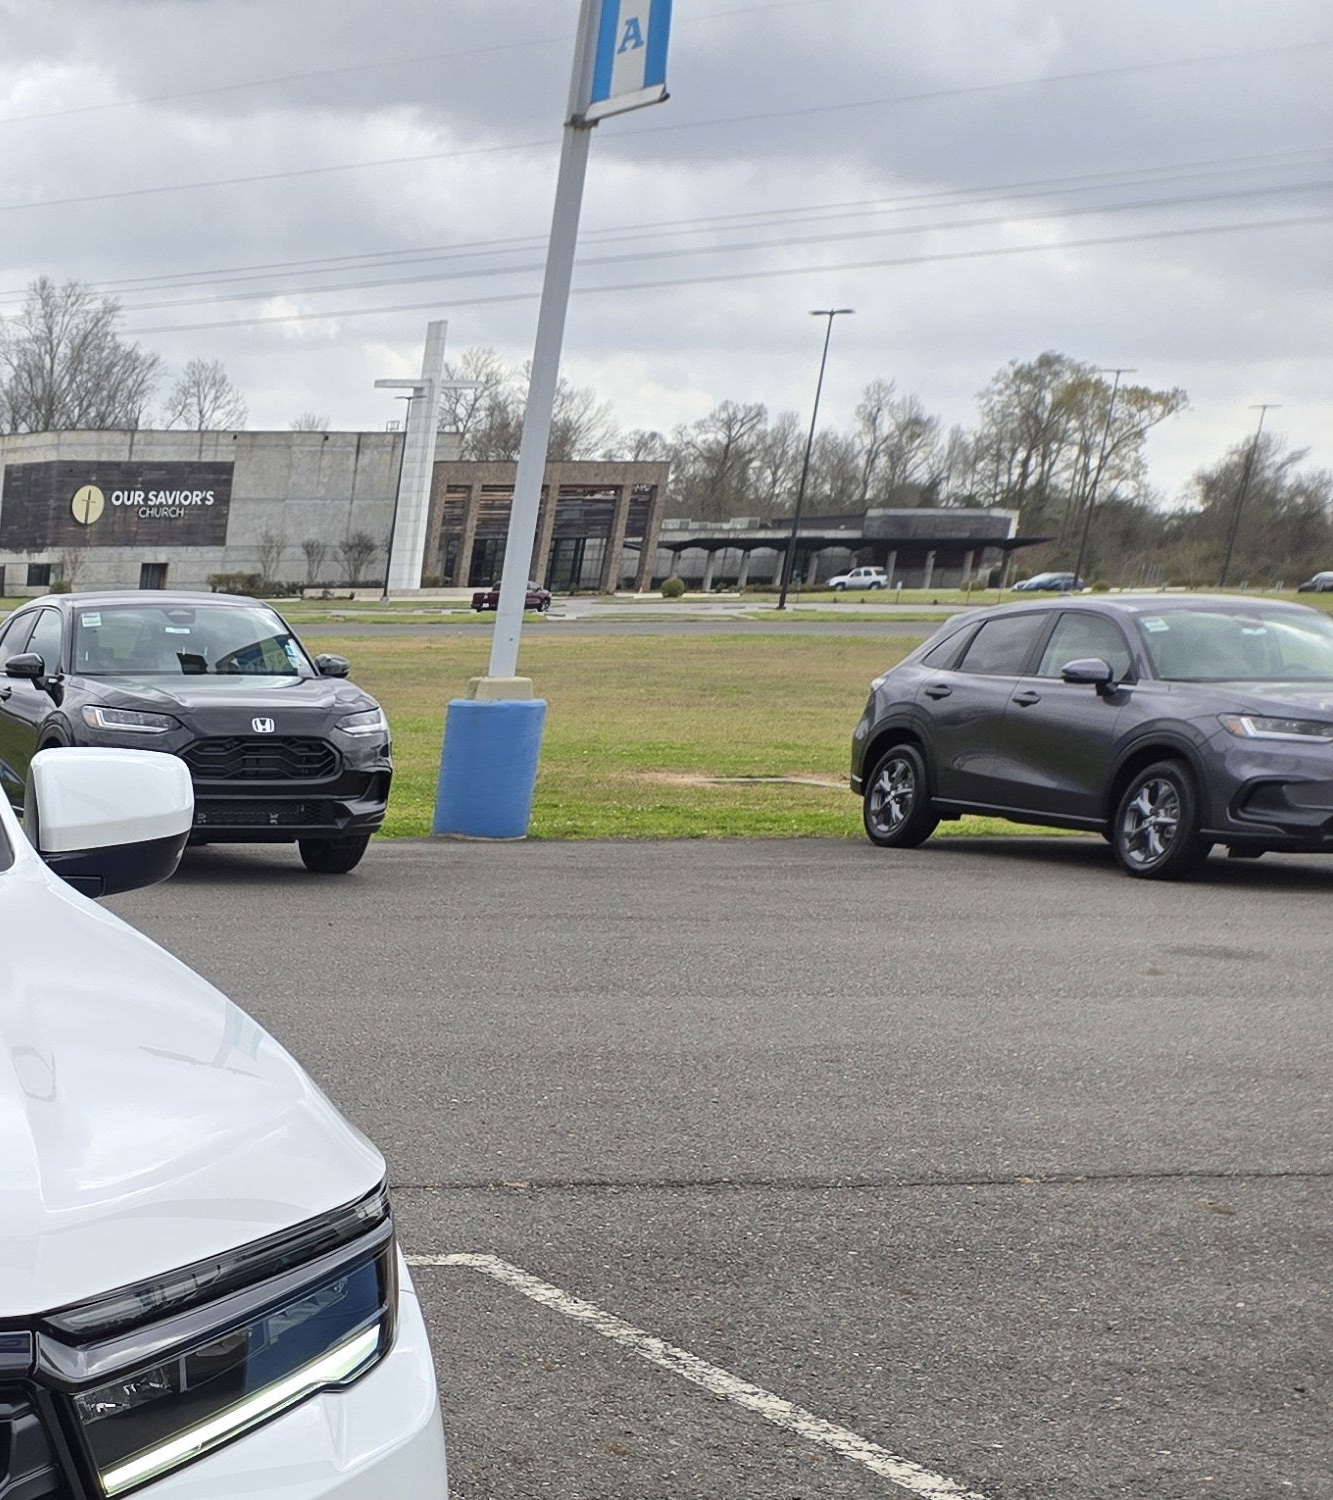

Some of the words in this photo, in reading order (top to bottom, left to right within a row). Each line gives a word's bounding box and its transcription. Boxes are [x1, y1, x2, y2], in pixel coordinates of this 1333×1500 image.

[111, 490, 144, 506] OUR
[147, 490, 215, 506] SAVIOR'S
[138, 506, 184, 519] CHURCH
